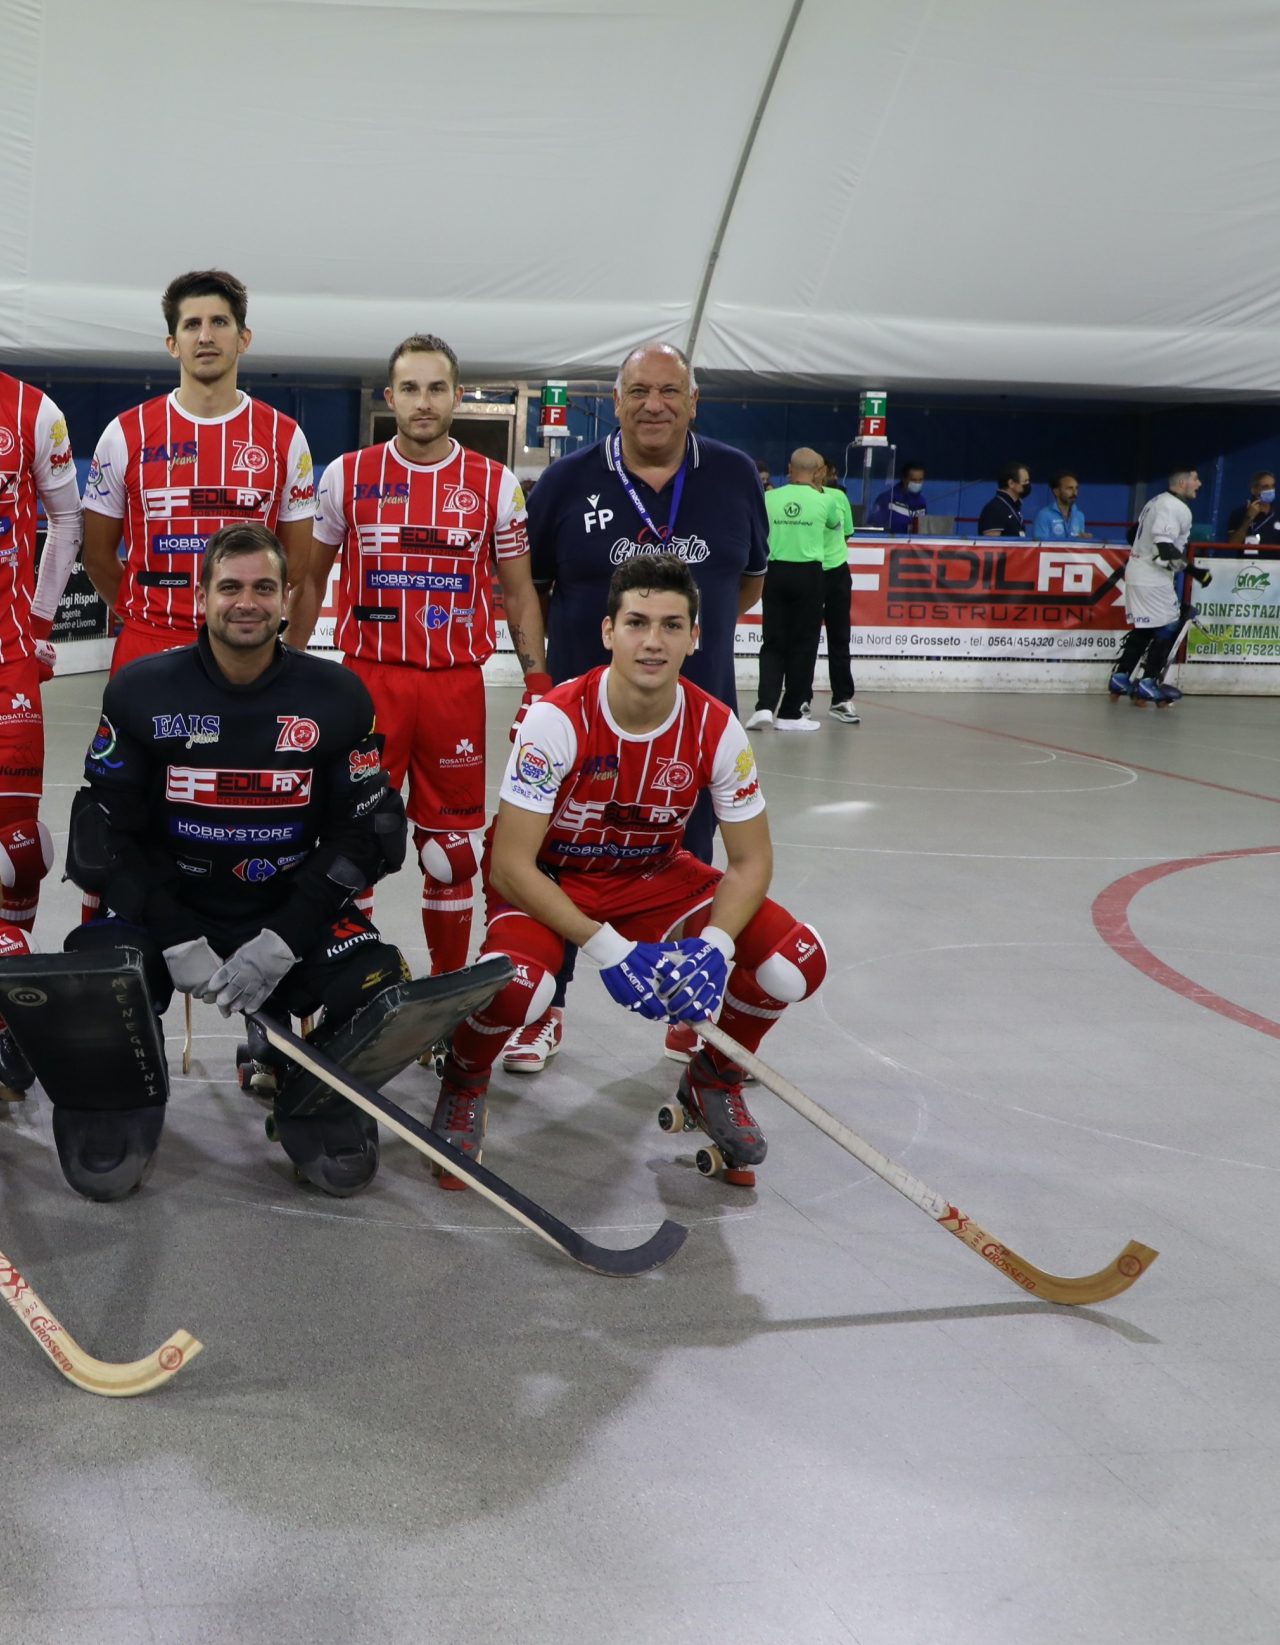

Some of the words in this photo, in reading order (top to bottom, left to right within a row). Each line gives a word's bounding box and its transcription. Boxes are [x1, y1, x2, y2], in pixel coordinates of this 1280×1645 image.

[551, 389, 562, 403] T
[871, 400, 882, 414] T
[551, 409, 561, 423] F
[870, 420, 880, 434] F
[141, 441, 198, 464] FAIS
[615, 460, 628, 486] macron
[354, 483, 409, 500] FAIS
[628, 488, 646, 514] macron
[583, 508, 614, 533] FP
[371, 574, 463, 588] HOBBYSTORE
[75, 591, 99, 607] Rispoli
[62, 610, 82, 619] agente
[887, 604, 1094, 623] COSTRUZIONI
[77, 619, 96, 629] Livorno
[869, 634, 892, 645] Nord
[895, 634, 908, 645] 69
[910, 634, 961, 647] Grosseto
[970, 635, 985, 647] tel.
[988, 635, 1055, 648] 0564/454320
[1097, 636, 1116, 648] 608
[1224, 643, 1245, 655] 349
[152, 713, 220, 740] FAIS
[275, 715, 320, 752] 70
[523, 752, 547, 769] FISR
[178, 821, 293, 839] HOBBYSTORE
[558, 843, 663, 857] HOBBYSTORE
[620, 962, 646, 994] ELKING
[111, 977, 158, 1097] MENEGHINI
[981, 1243, 1037, 1290] GROSSETO
[29, 1316, 74, 1372] GROSSETO
